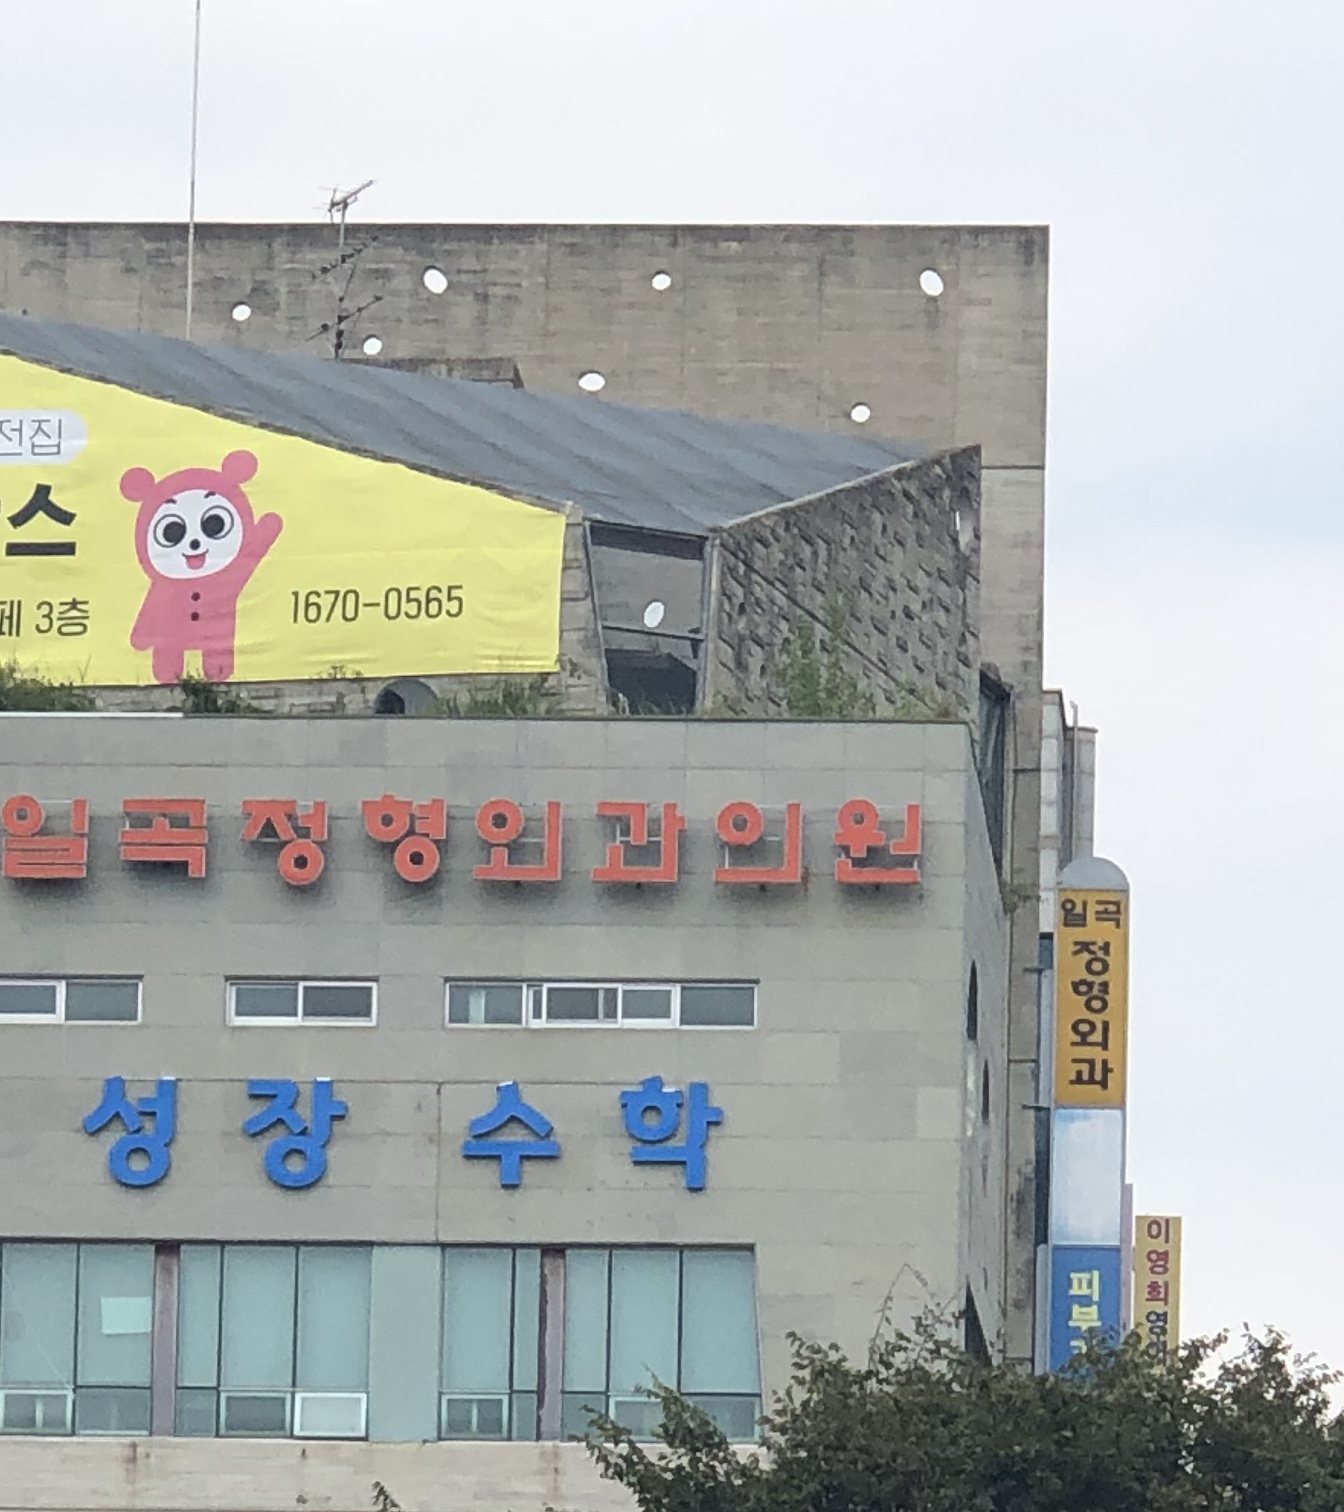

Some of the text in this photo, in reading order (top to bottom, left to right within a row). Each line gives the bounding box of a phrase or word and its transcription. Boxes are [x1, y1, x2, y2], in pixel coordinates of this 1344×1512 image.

[33, 598, 92, 639] 3층
[290, 583, 465, 628] 1670-0565
[0, 793, 924, 887] 일곡정형외과의원
[1060, 898, 1122, 1092] 일곡 정형외과
